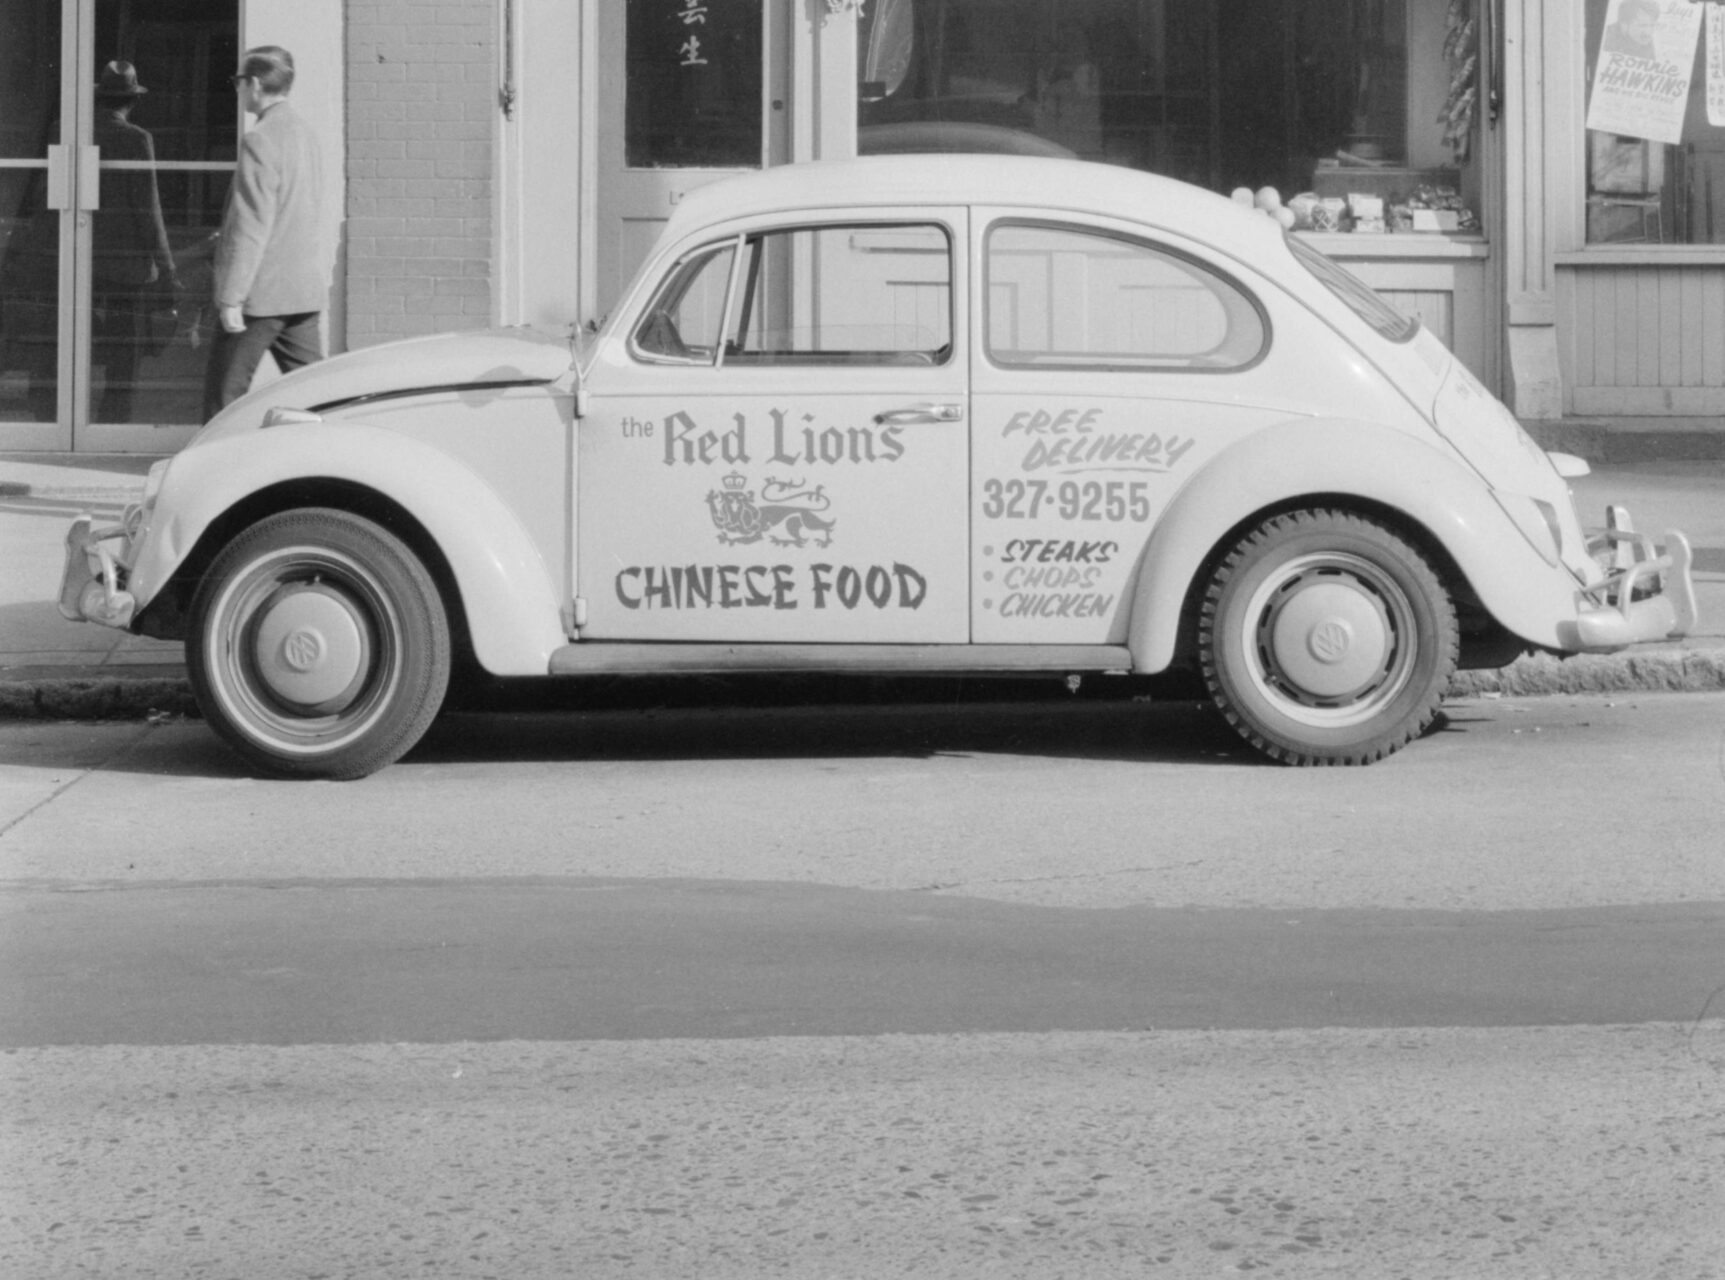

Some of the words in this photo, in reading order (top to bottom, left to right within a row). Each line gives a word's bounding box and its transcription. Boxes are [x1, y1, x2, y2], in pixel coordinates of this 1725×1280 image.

[1609, 52, 1680, 77] Ronnie
[1600, 67, 1687, 98] HAWKINS
[621, 416, 654, 437] the
[662, 410, 751, 466] Red
[766, 407, 905, 466] Lions
[1001, 408, 1103, 438] FREE
[1020, 432, 1196, 471] DELIVERY
[1001, 539, 1119, 563] STEAKS
[615, 563, 798, 609] CHINESE
[809, 561, 927, 610] FOOD
[1003, 566, 1102, 590] CHOPS
[1000, 592, 1114, 618] CHICKEN
